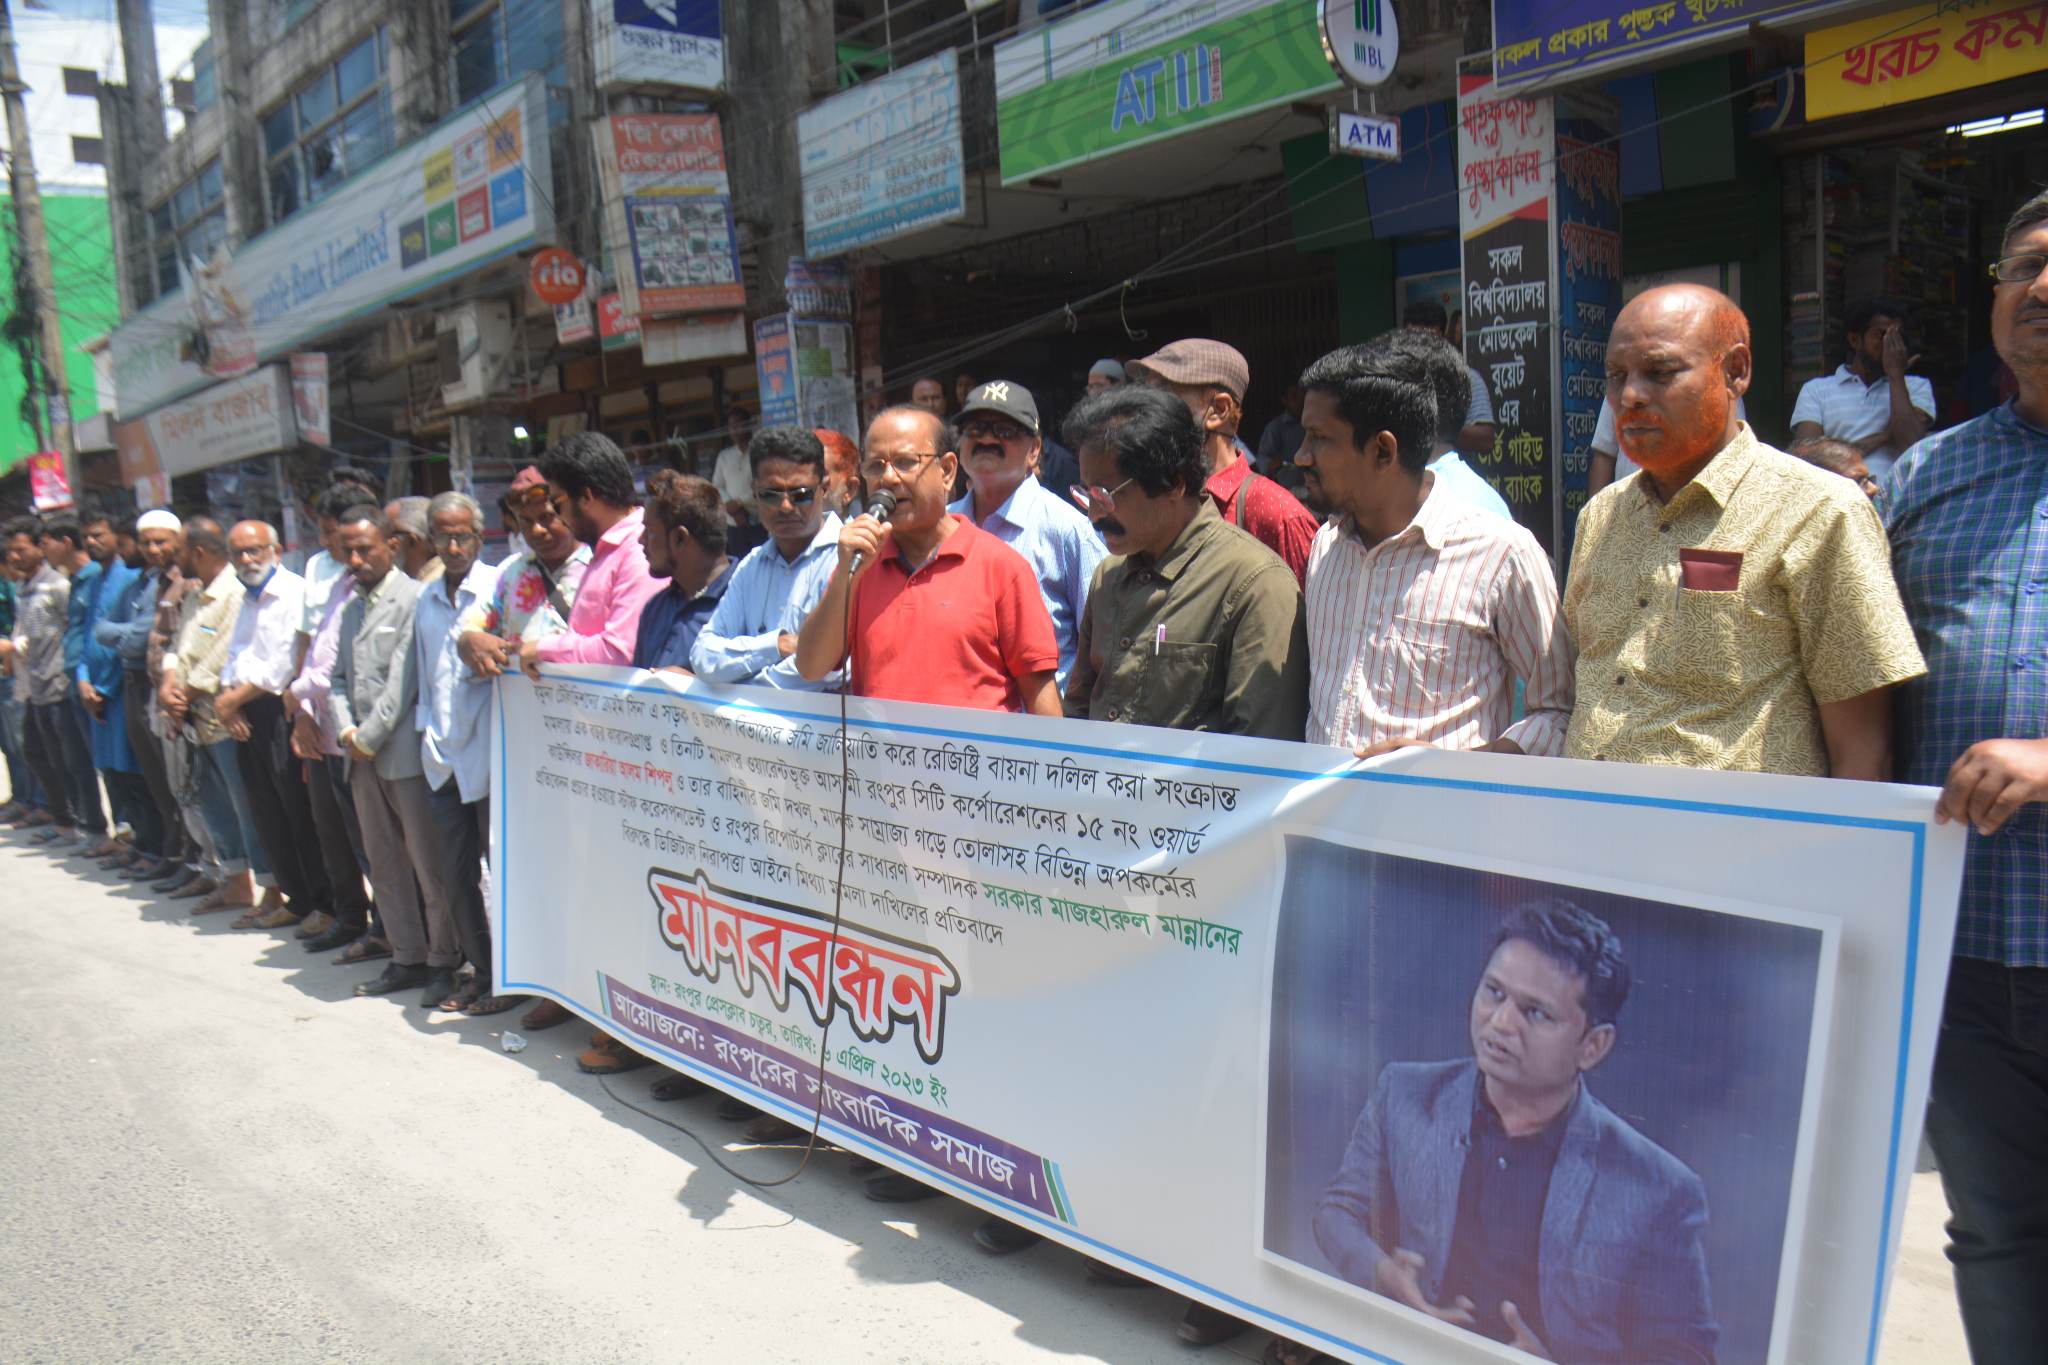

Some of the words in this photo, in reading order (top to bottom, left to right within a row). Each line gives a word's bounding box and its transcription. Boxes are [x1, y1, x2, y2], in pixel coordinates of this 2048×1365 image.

[1496, 37, 1540, 69] কল
[1547, 18, 1610, 55] প্রকার
[1841, 27, 1942, 85] খরচ
[1348, 122, 1392, 149] ATM
[538, 255, 579, 287] ria
[1488, 245, 1523, 276] সকল
[1468, 277, 1546, 318] বিশ্ববিদ্যালয়
[1576, 302, 1607, 326] সকল
[1479, 316, 1538, 354] মেডিকেল
[1490, 352, 1526, 397] বুয়েট
[1499, 400, 1520, 427] এর
[1508, 429, 1544, 466] গাইড
[1563, 445, 1589, 474] ভর্তি
[1504, 473, 1543, 504] ব্যাংক
[735, 714, 785, 745] বিভাগের
[786, 724, 814, 752] জমি
[883, 743, 918, 767] করে
[987, 755, 1039, 786] বায়না
[1045, 757, 1099, 795] দলিল
[1105, 771, 1147, 802] করা
[1153, 778, 1241, 812] সংক্রান্ত
[670, 733, 704, 760] তিনটি
[865, 780, 906, 812] রংপুর
[911, 780, 947, 813] সিটি
[950, 790, 1068, 834] কর্পোরেশনের
[1076, 813, 1104, 841] ১৫
[1111, 819, 1141, 850] নং
[1149, 823, 1211, 855] ওয়ার্ড
[688, 776, 713, 798] তার
[715, 777, 758, 806] বাহিনীর
[759, 788, 781, 814] জমি
[857, 816, 910, 848] সাম্রাজ্য
[914, 828, 948, 859] গড়ে
[953, 838, 1030, 875] তোলাসহ
[1035, 843, 1091, 889] বিভিন্ন
[1096, 866, 1197, 899] অপকর্মের
[654, 827, 697, 861] ডিজিটাল
[699, 839, 746, 875] নিরাপত্তা
[749, 855, 793, 884] আইনে
[795, 862, 827, 896] মিথ্যা
[870, 889, 930, 926] দাখিলের
[934, 906, 1004, 946] প্রতিবাদে
[711, 815, 721, 832] ও
[726, 816, 761, 847] রংপুর
[858, 852, 908, 885] সাধারণ
[913, 866, 978, 900] সম্পাদক
[981, 882, 1044, 917] সরকার
[1047, 896, 1152, 937] মাজহারুল
[1156, 913, 1244, 957] মান্নানের
[654, 876, 949, 1046] মানববন্ধন
[673, 982, 703, 1009] রংপুর
[779, 1024, 817, 1055] তারিখ:
[836, 1046, 877, 1080] এপ্রিল
[880, 1063, 924, 1096] ২০২৩
[929, 1073, 949, 1109] ইং
[611, 990, 705, 1051] আয়োজনে:
[711, 1033, 800, 1094] রংপুরের
[803, 1072, 923, 1147] সাংবাদিক
[927, 1125, 1018, 1192] সমাজ
